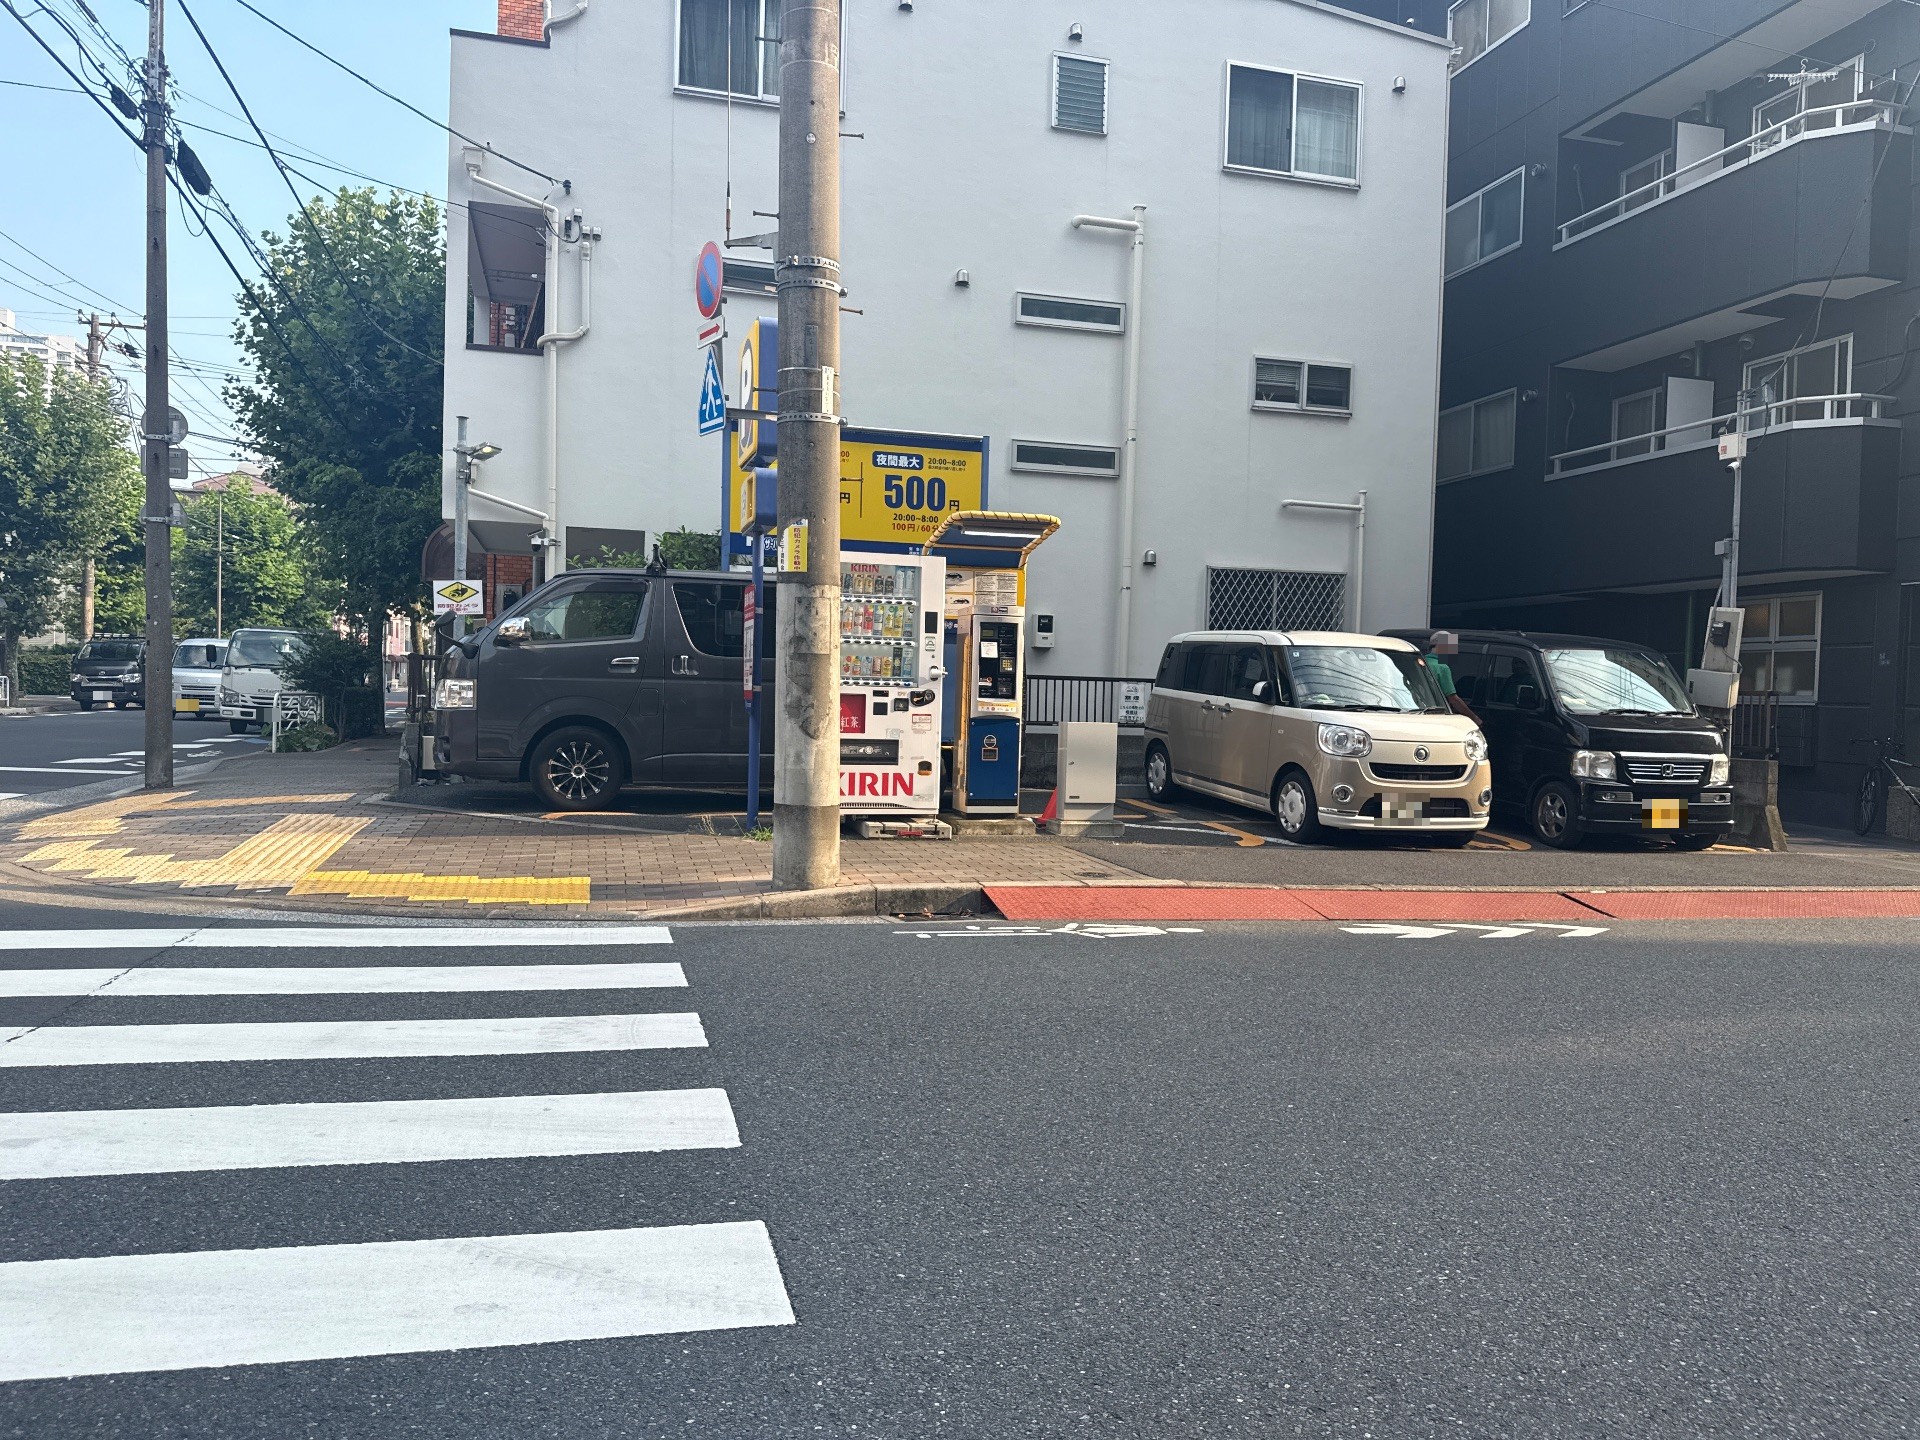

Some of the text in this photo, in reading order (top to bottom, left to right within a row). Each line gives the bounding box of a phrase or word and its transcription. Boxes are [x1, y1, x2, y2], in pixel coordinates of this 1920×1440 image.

[876, 454, 920, 468] 夜間最大
[884, 474, 946, 511] 500
[949, 500, 960, 511] 円
[850, 563, 880, 573] KIRIN
